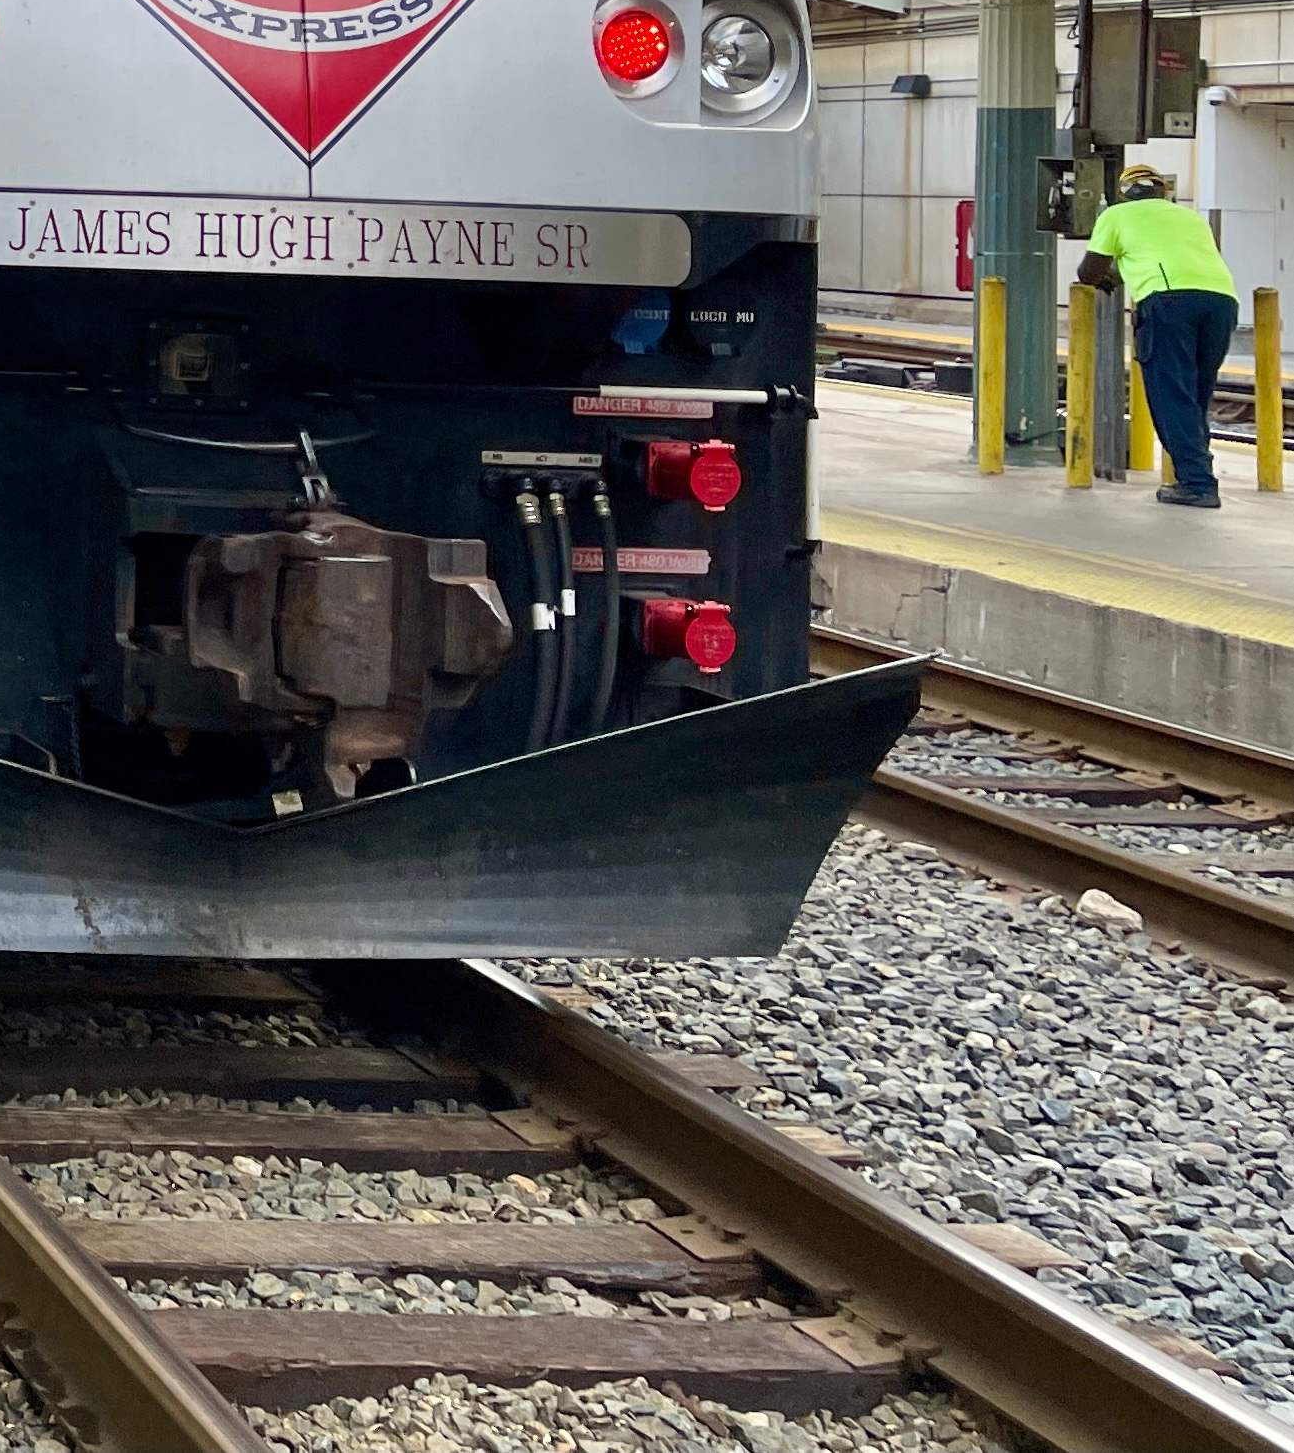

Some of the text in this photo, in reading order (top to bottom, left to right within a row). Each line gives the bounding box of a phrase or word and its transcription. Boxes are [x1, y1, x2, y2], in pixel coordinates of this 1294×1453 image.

[8, 206, 590, 269] JAMES HUGH PAYNE SR
[690, 311, 755, 324] LOCO MU
[577, 397, 641, 411] DANGER
[573, 553, 636, 567] DANER
[642, 554, 664, 567] 480
